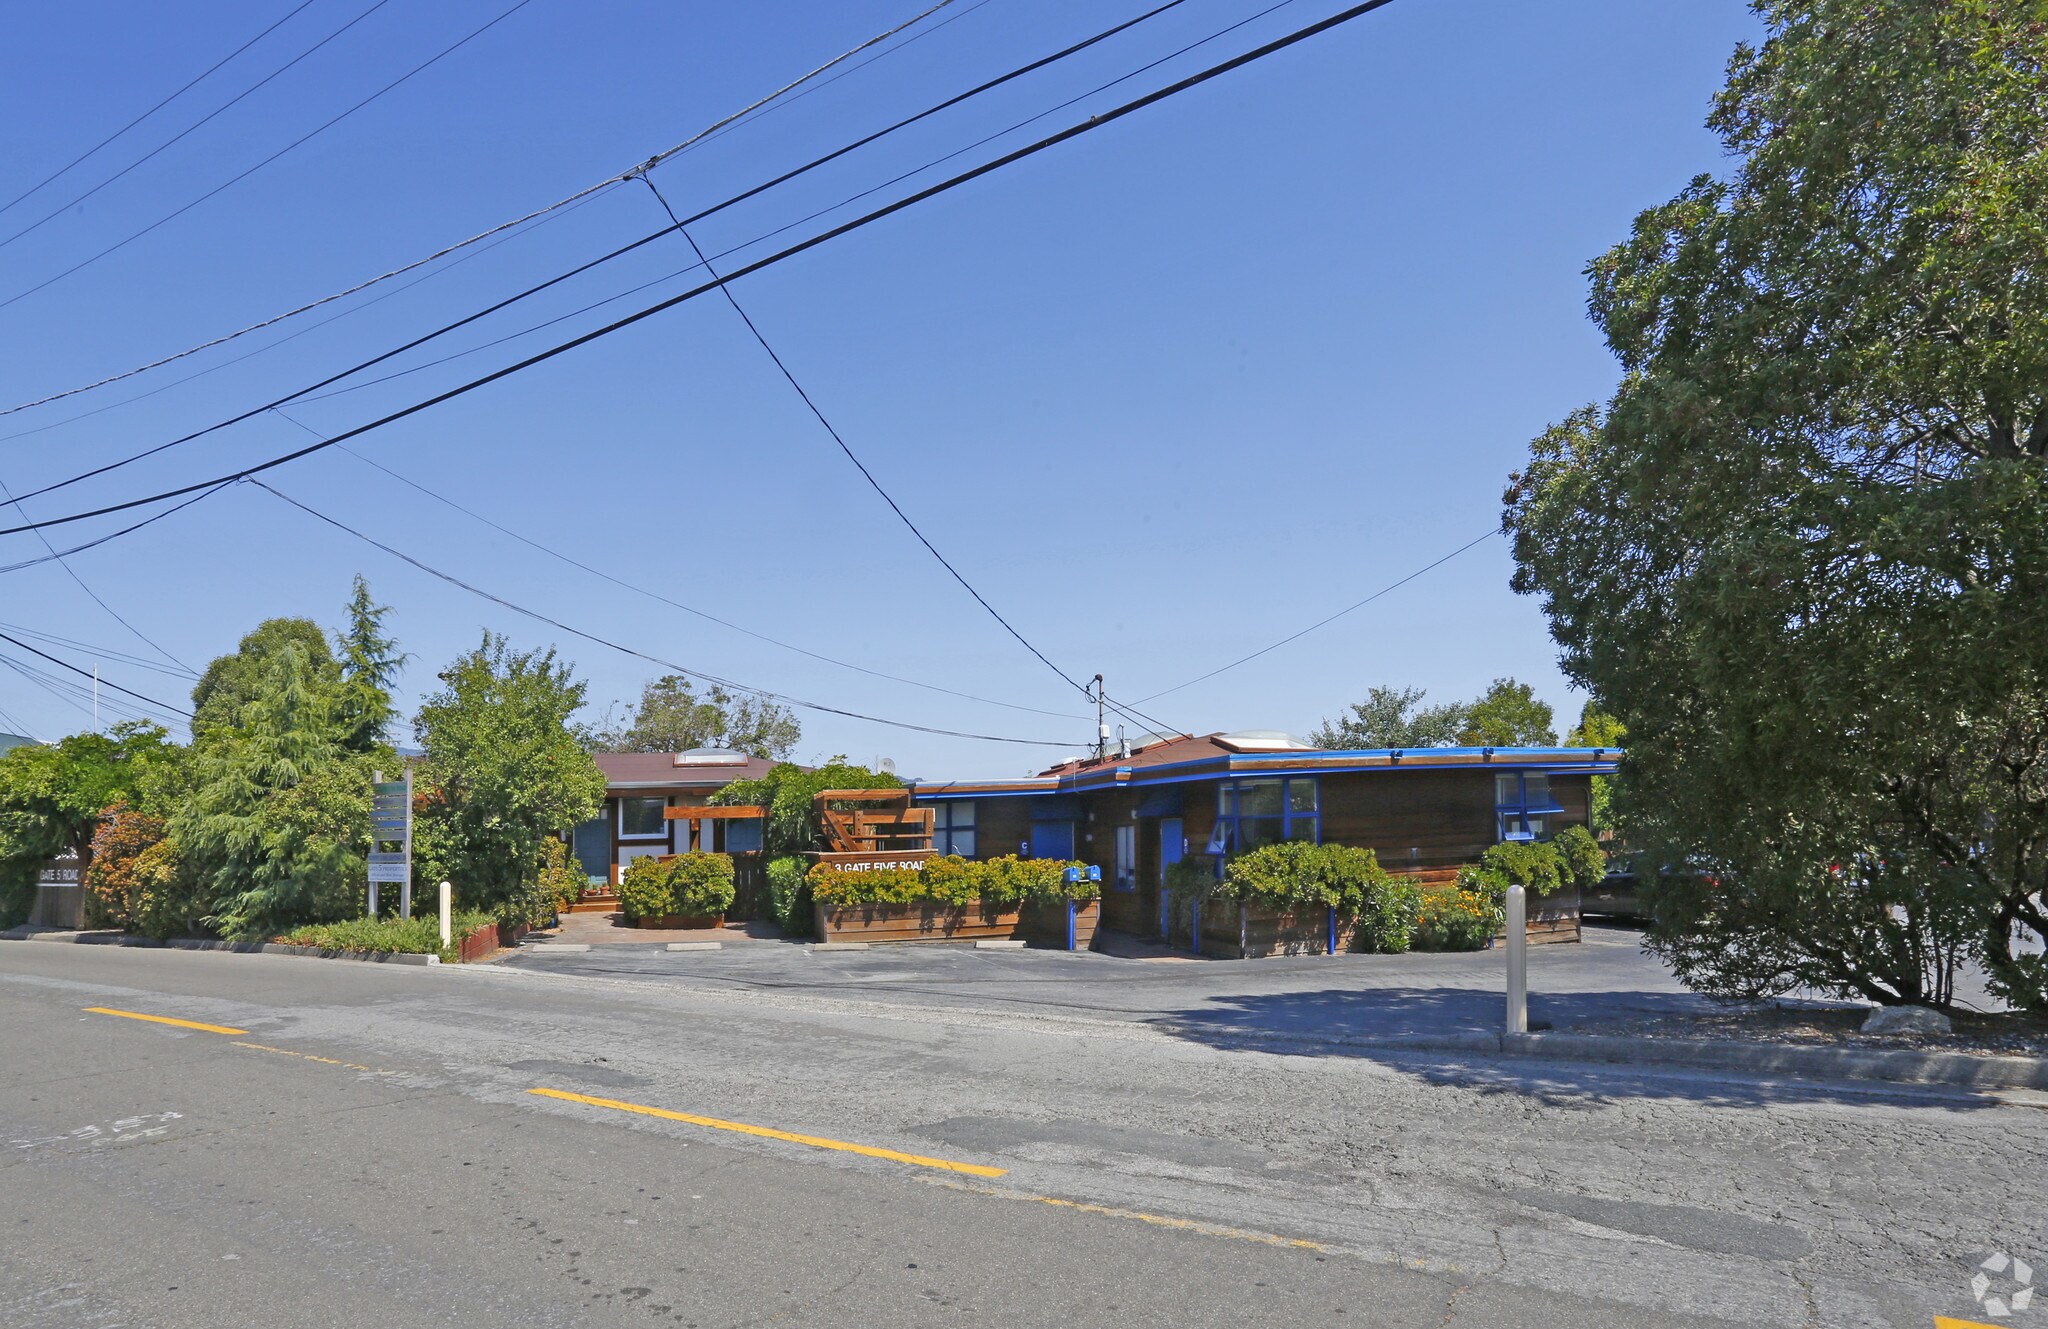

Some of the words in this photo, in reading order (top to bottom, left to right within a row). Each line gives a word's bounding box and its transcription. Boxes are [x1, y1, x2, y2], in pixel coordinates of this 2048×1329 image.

[1021, 842, 1028, 850] C
[835, 863, 842, 872] 3
[844, 862, 871, 873] GATE
[874, 861, 897, 872] FIVE
[40, 869, 55, 880] GATE
[56, 869, 61, 880] 5
